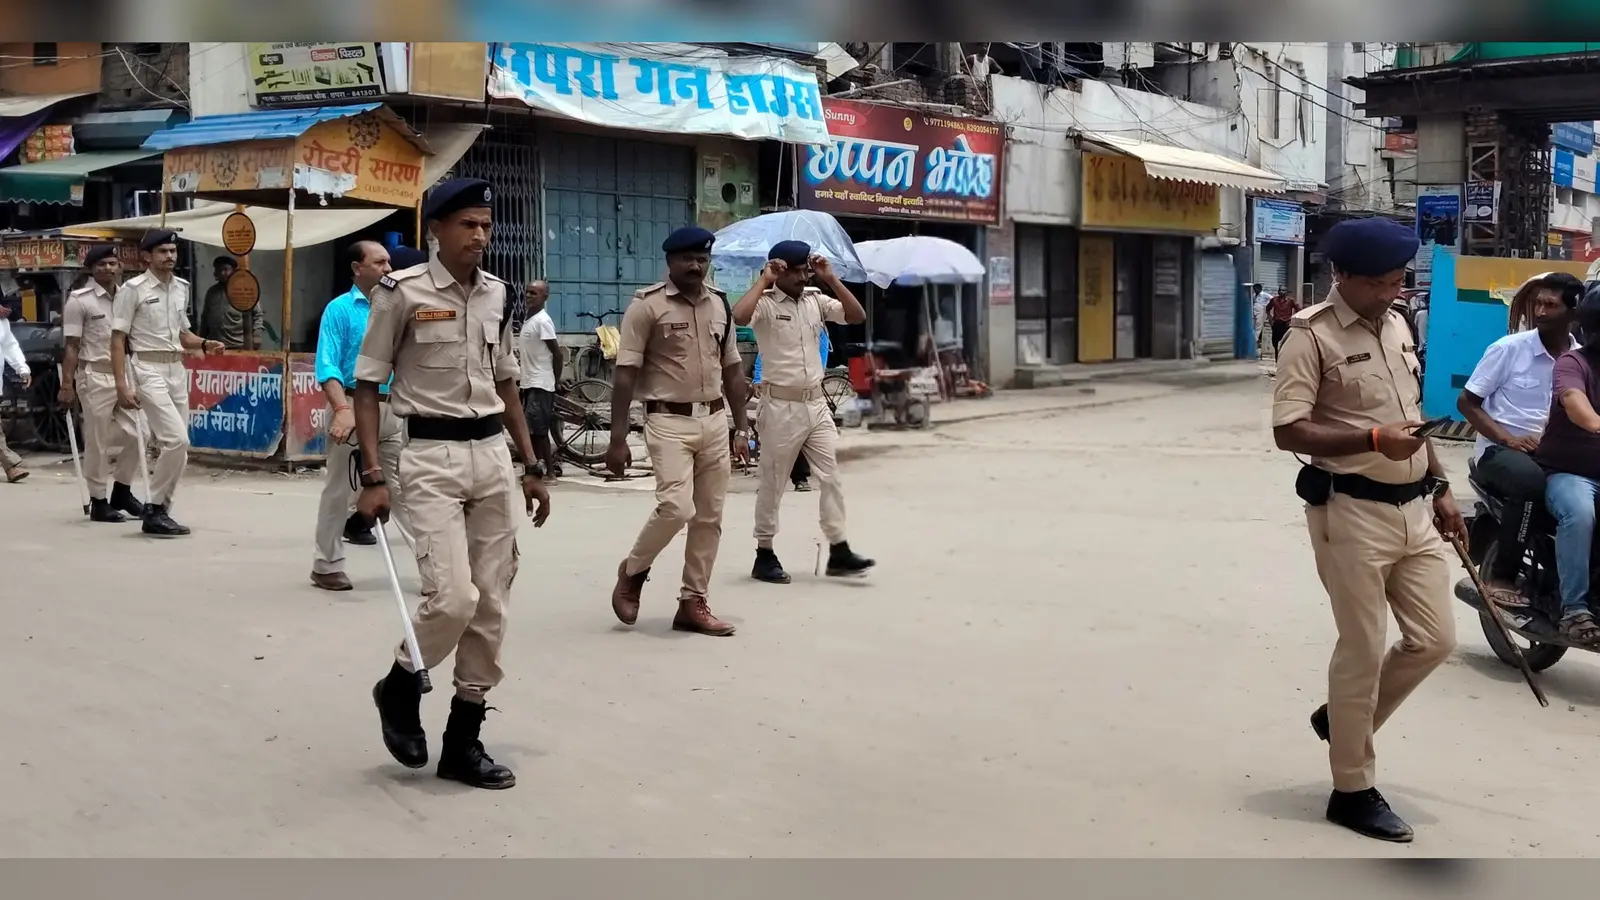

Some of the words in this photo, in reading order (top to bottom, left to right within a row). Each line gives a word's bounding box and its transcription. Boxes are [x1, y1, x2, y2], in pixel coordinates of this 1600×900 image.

[630, 57, 714, 109] गन
[722, 71, 823, 121] हाउस
[824, 109, 856, 125] Sunny
[302, 139, 364, 176] रोटरी
[368, 157, 421, 186] सारण
[809, 135, 919, 187] छप्पन
[196, 369, 247, 397] यातायात
[248, 366, 283, 407] पुलिस
[210, 405, 235, 432] सेवा
